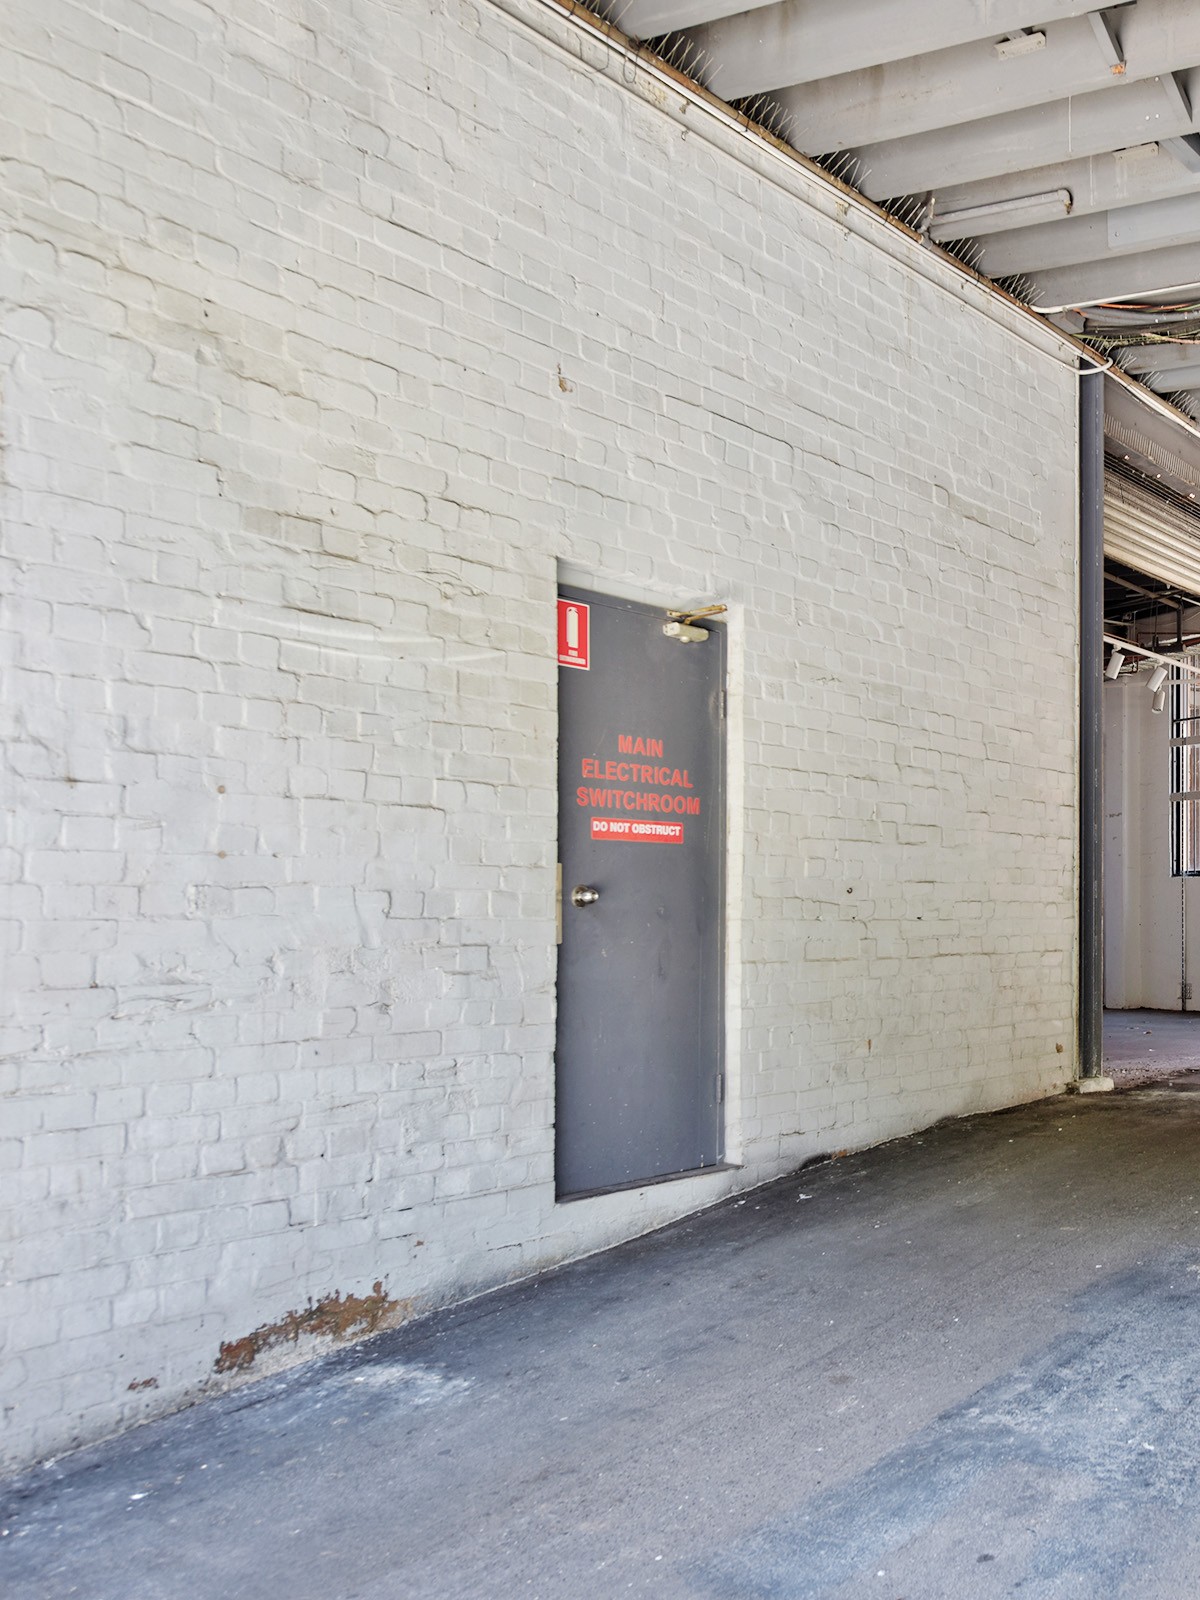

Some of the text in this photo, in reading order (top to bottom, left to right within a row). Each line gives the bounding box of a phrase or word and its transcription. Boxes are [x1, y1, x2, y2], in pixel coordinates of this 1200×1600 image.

[618, 734, 663, 758] MAIN
[582, 758, 694, 788] ELECTRICAL
[576, 786, 700, 815] SWITCHROOM
[592, 821, 682, 836] DO NOT OBSTRUCT
